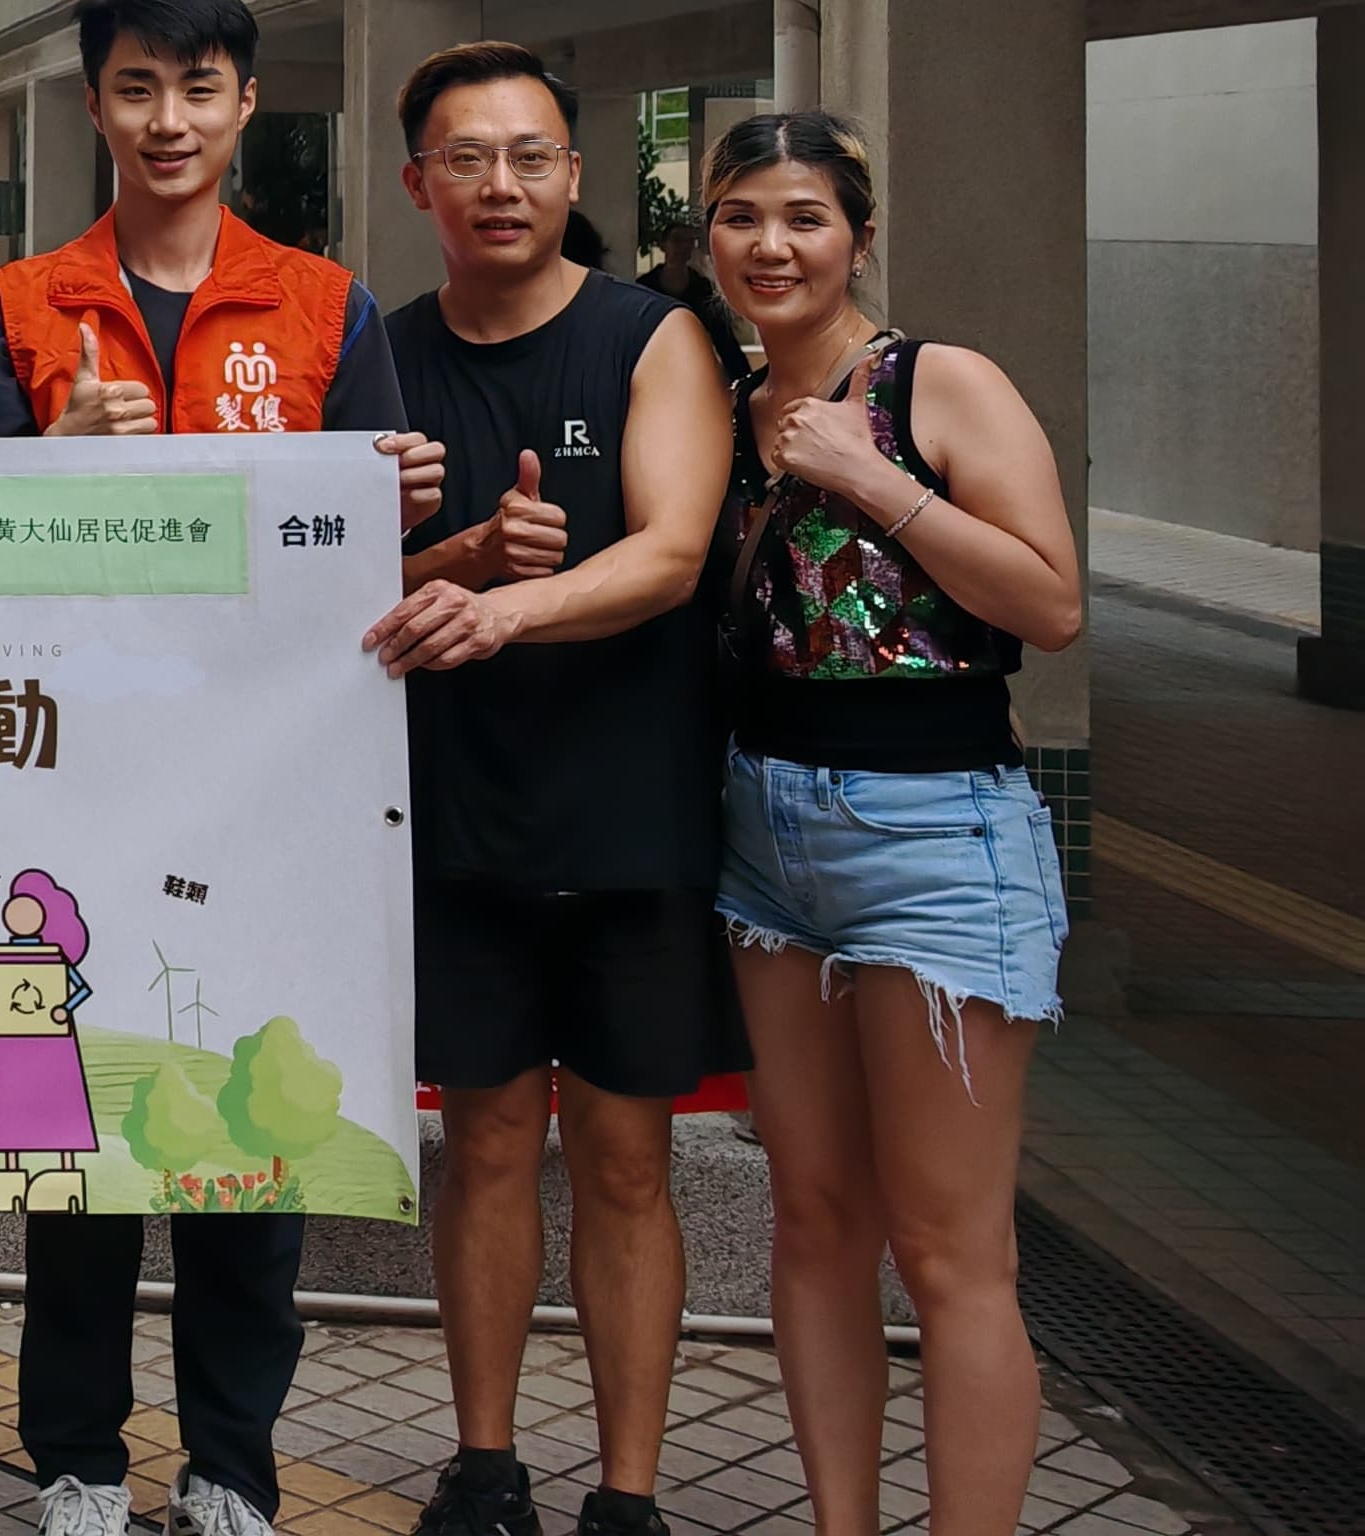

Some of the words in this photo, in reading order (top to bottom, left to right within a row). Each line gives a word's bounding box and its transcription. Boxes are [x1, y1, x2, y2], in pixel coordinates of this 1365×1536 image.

[564, 420, 590, 445] R
[277, 514, 346, 547] 合辦
[162, 874, 210, 906] 鞋類
